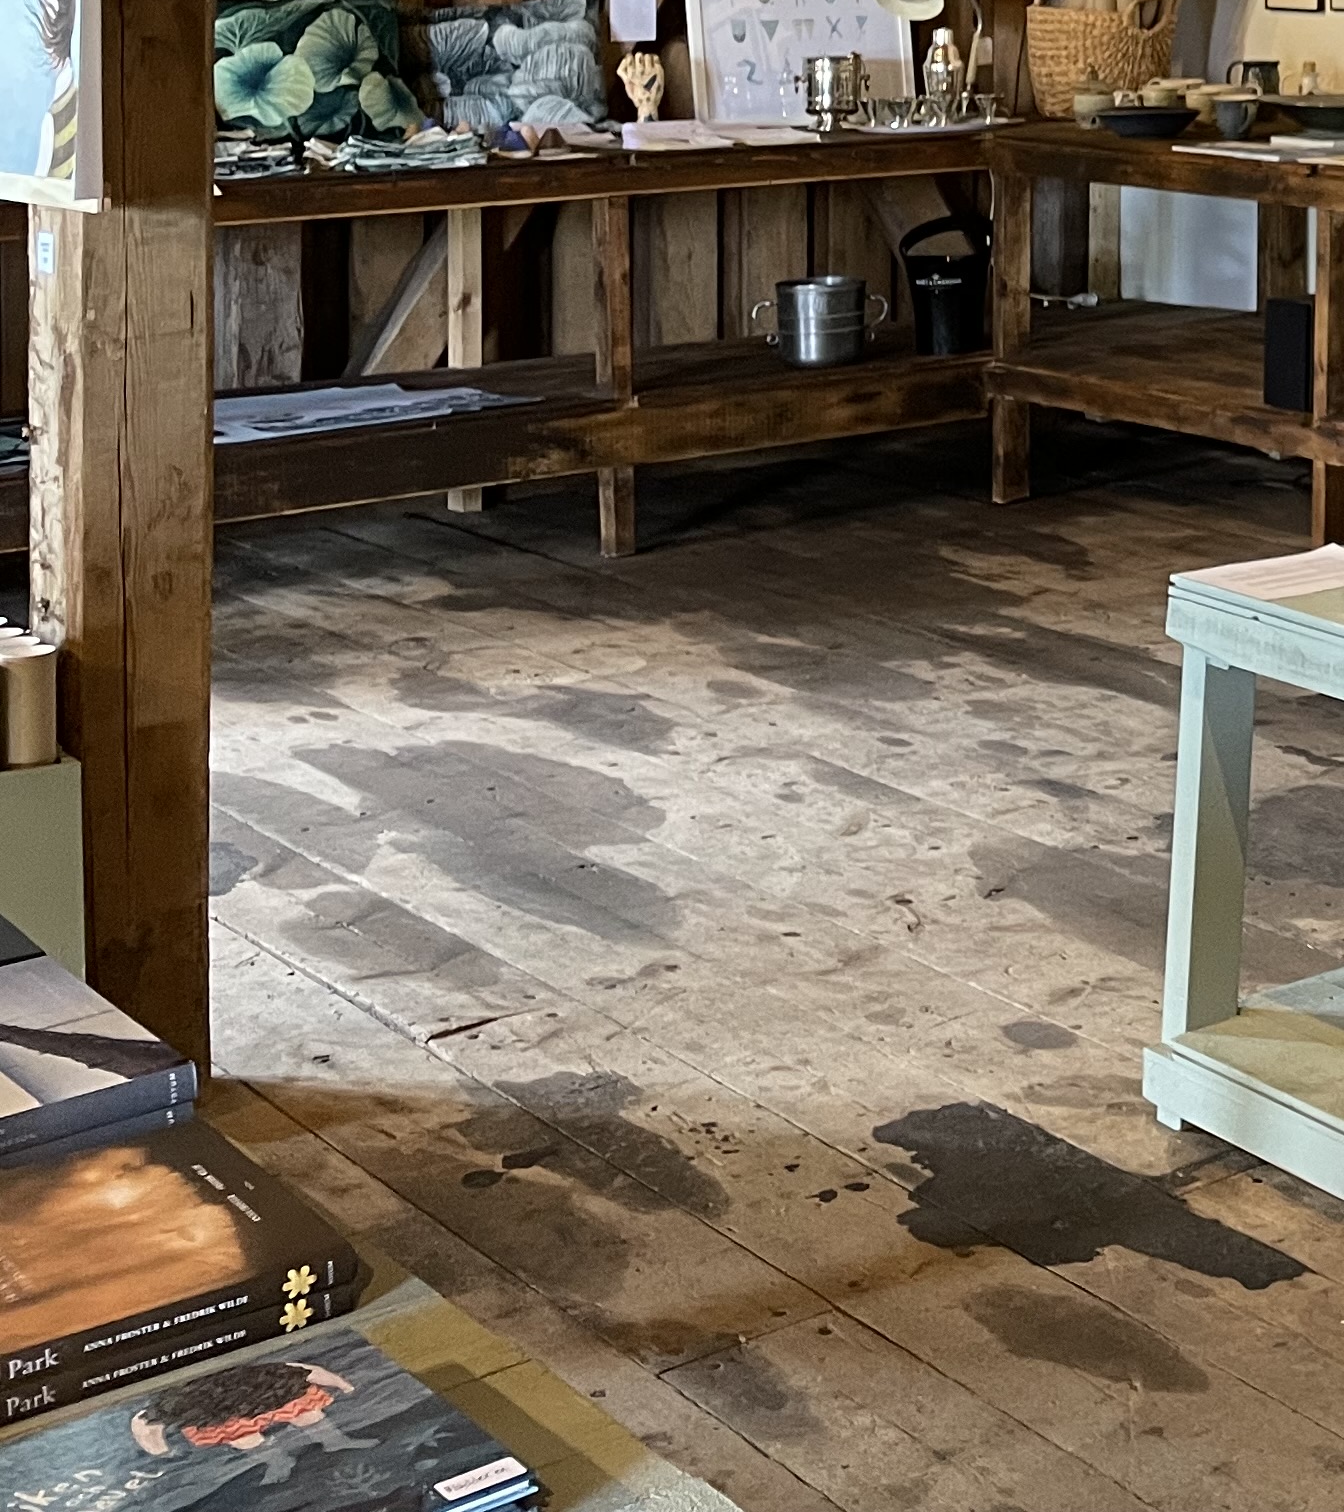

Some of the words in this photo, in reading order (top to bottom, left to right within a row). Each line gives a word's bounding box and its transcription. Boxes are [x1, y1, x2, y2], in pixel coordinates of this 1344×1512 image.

[8, 1348, 59, 1380] Park
[83, 1337, 113, 1354] ANNA
[174, 1305, 216, 1325] FREDRIK
[6, 1386, 56, 1416] Park
